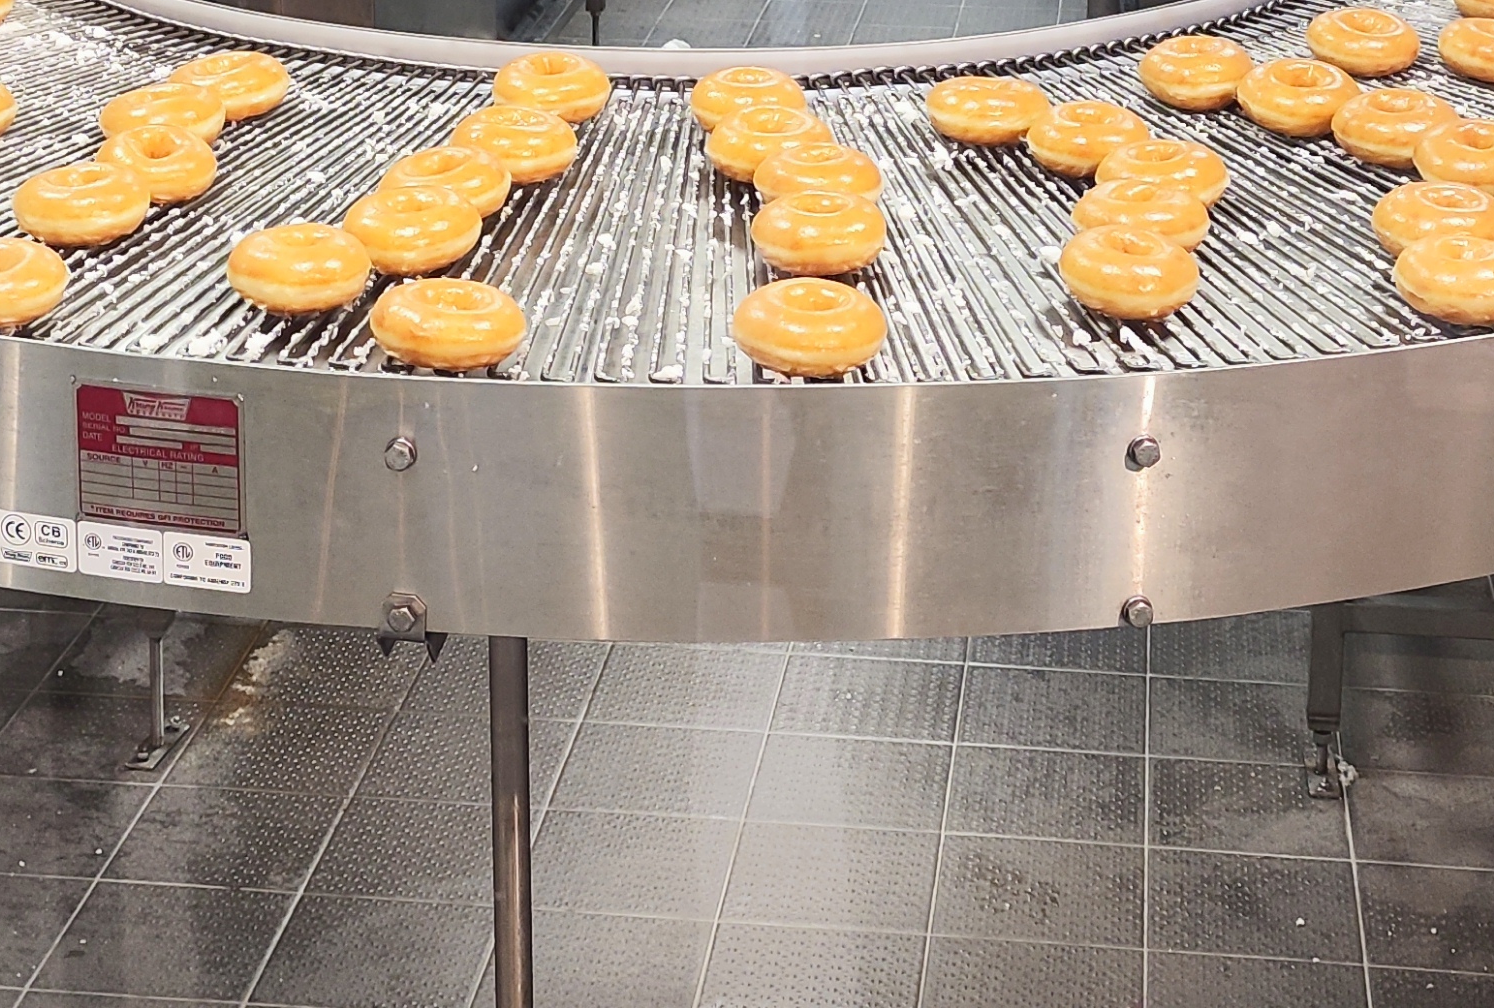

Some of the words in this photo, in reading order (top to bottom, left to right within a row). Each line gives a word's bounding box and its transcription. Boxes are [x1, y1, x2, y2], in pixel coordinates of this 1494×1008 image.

[82, 411, 111, 423] MODEL
[82, 422, 111, 432] SERIAL
[82, 431, 103, 442] DATE
[86, 452, 121, 463] SOURCE
[111, 444, 167, 459] ELECTRICAL
[169, 451, 205, 463] RATING
[95, 506, 114, 515] ITEM
[116, 509, 156, 520] REQUIRES
[173, 515, 225, 528] PROTECTION
[5, 520, 26, 541] CE
[41, 524, 61, 539] CB
